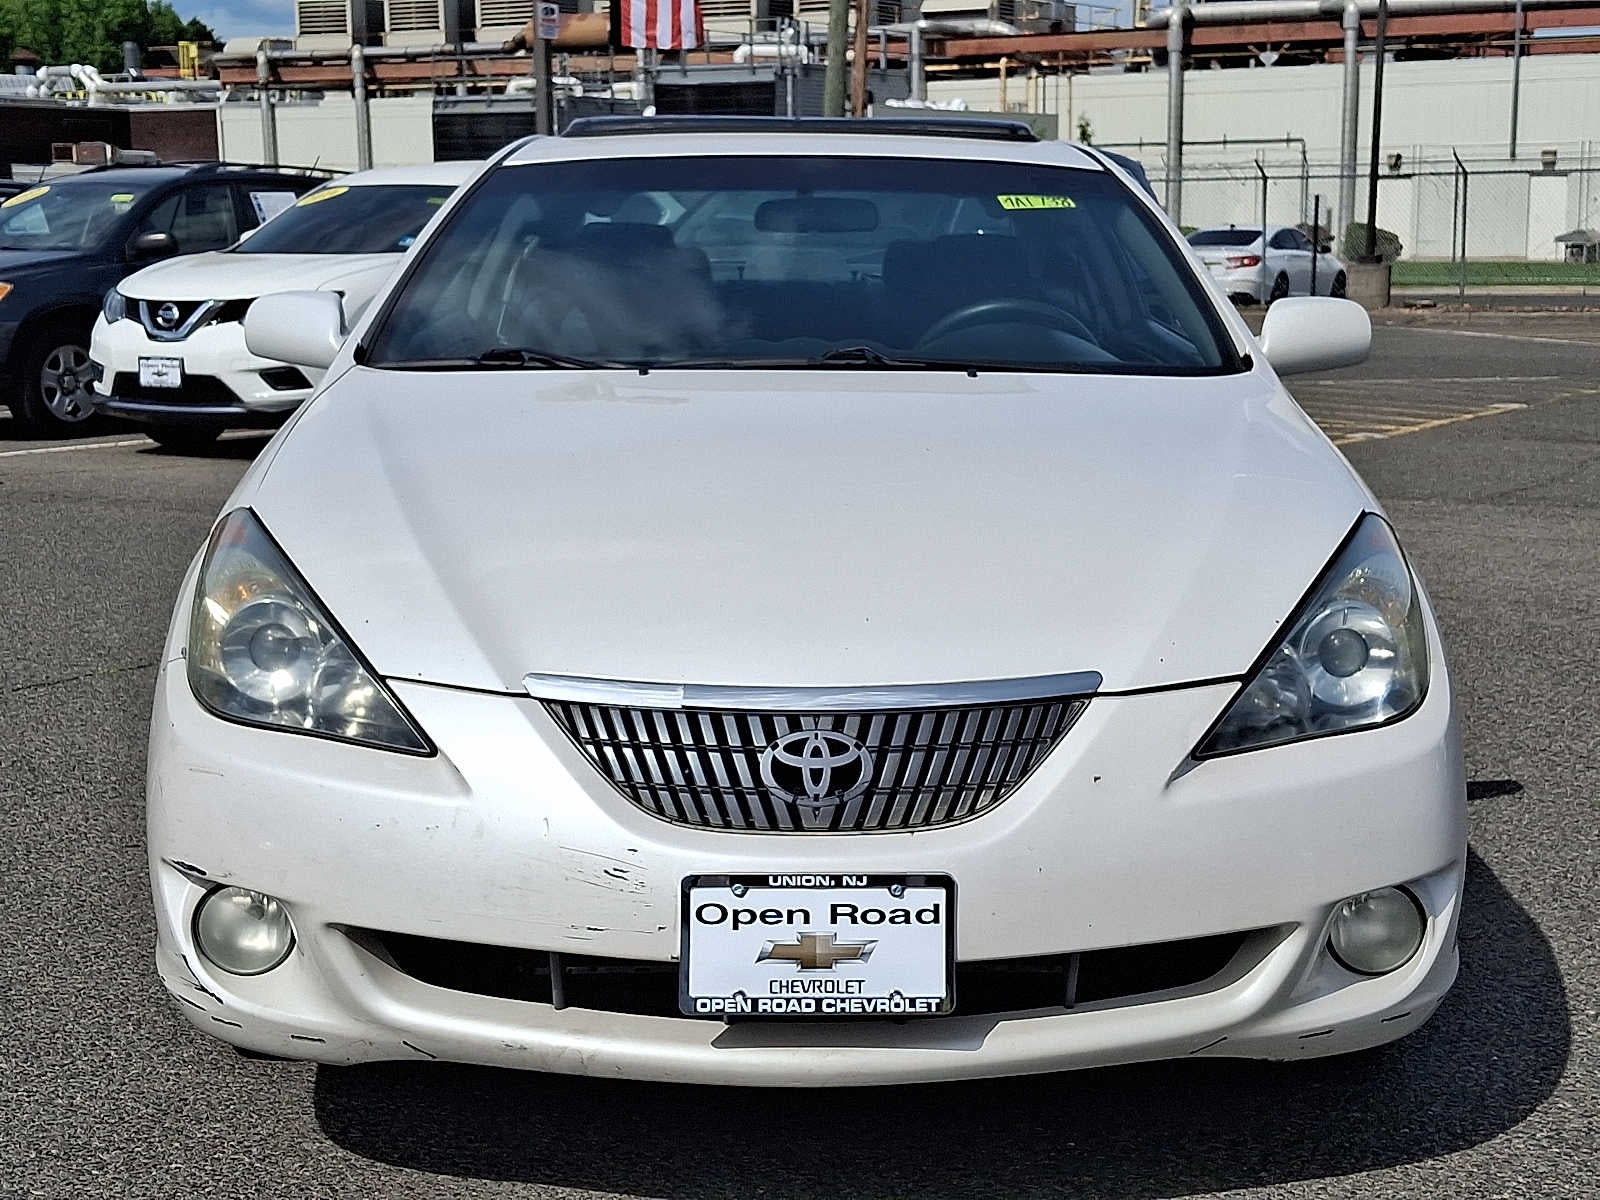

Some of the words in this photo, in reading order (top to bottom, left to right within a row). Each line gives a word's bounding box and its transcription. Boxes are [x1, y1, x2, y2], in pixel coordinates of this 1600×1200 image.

[768, 875, 835, 888] UNION,
[842, 875, 868, 887] NJ
[695, 903, 811, 930] Open
[829, 903, 940, 925] Road
[769, 979, 866, 994] CHEVROLET
[696, 998, 752, 1013] OPEN
[758, 998, 816, 1013] ROAD
[821, 998, 941, 1013] CHEVROLET
